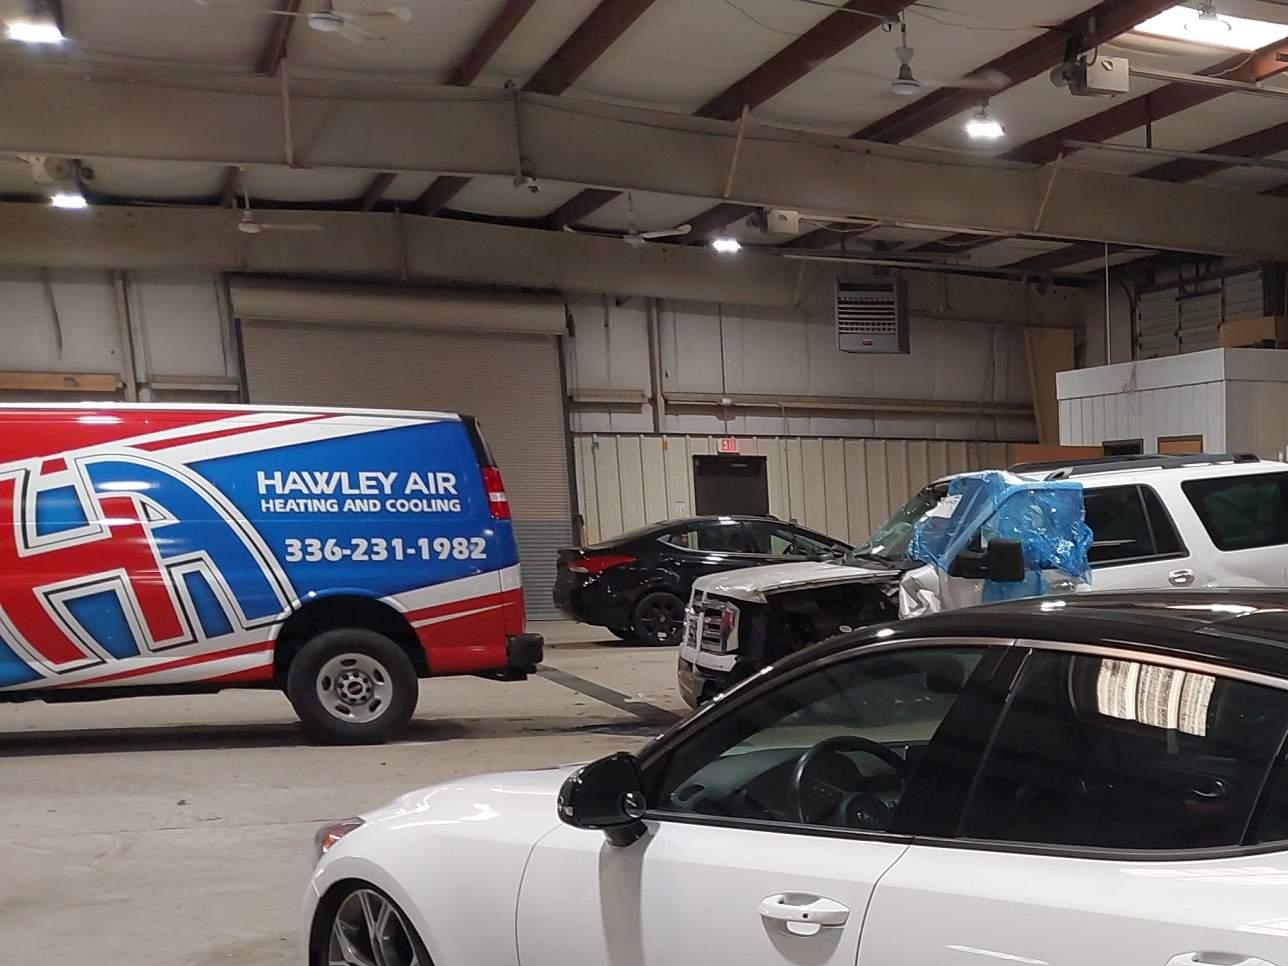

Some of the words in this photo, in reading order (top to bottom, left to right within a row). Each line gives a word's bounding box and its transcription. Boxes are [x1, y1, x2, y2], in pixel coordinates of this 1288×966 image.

[257, 472, 397, 494] HAWLEY
[405, 473, 457, 494] AIR
[262, 500, 338, 512] HEATING
[344, 500, 380, 511] AND
[386, 500, 460, 512] COOLING
[284, 538, 488, 562] 336-231-1982
